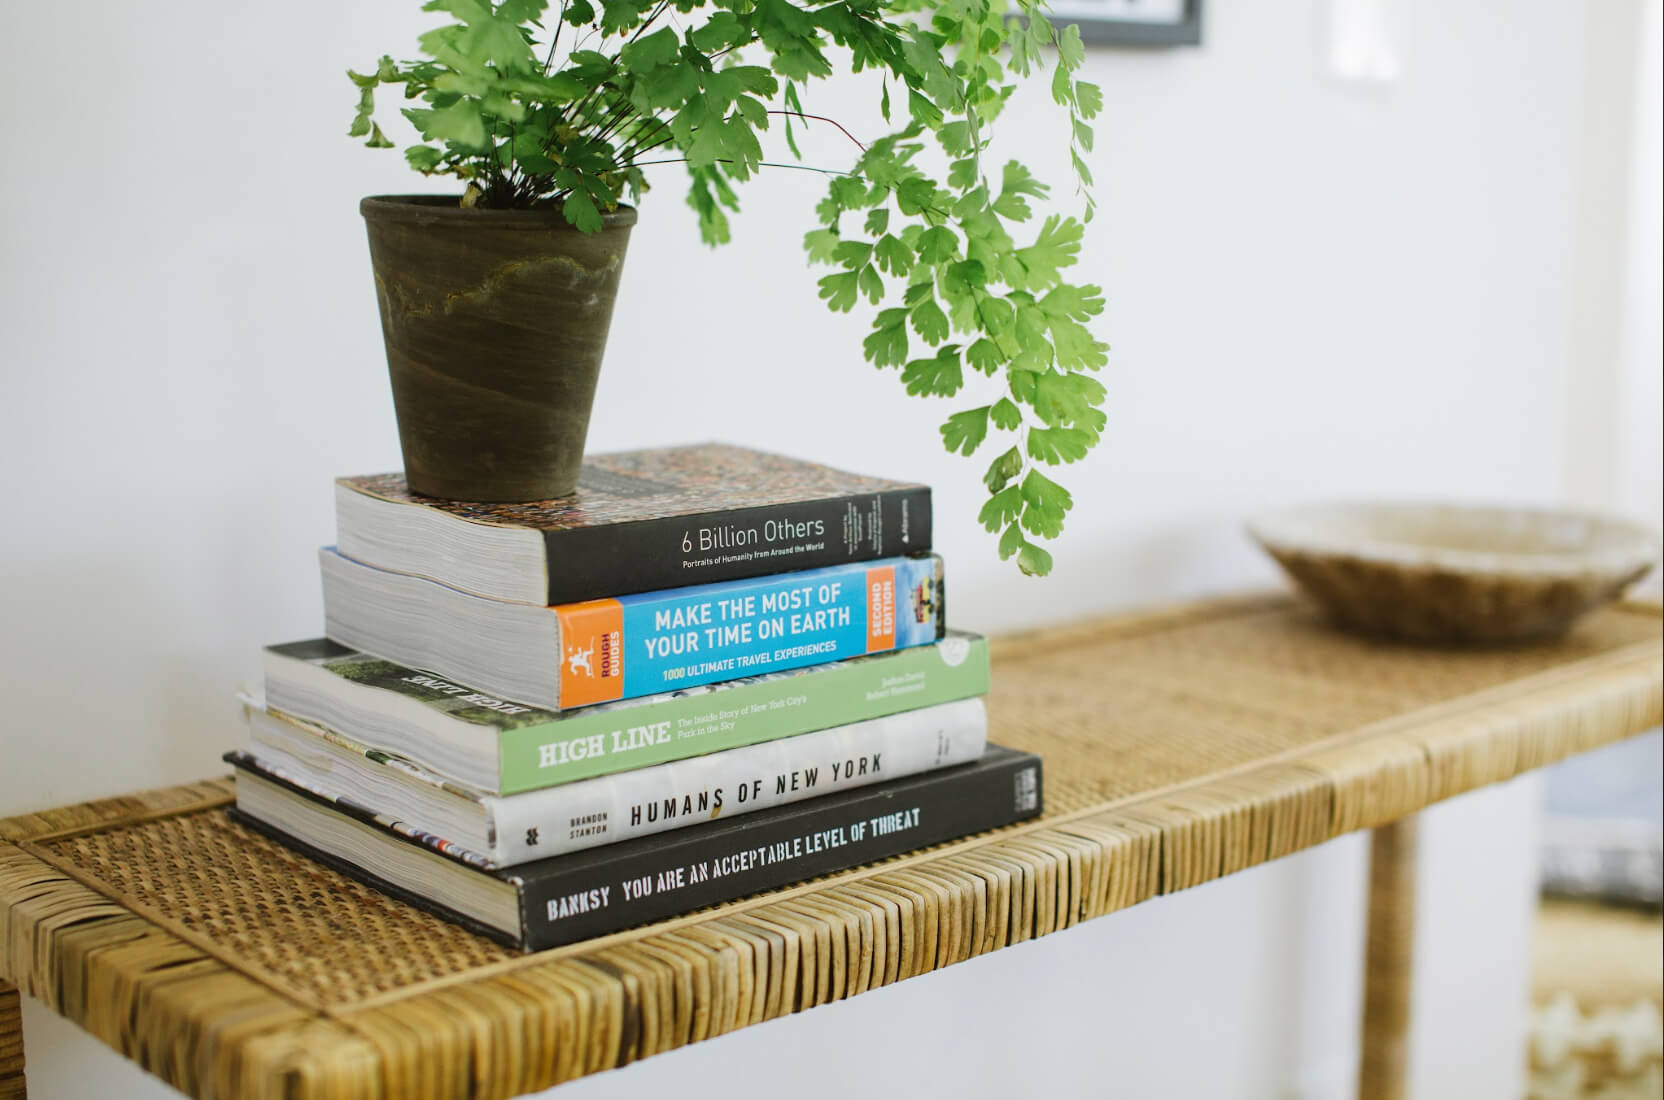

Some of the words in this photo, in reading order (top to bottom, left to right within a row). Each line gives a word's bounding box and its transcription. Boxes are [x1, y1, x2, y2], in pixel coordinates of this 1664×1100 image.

[682, 531, 692, 553] 6
[699, 524, 758, 551] Billion
[764, 518, 825, 542] Others
[683, 558, 713, 569] Portraits
[714, 556, 722, 565] of
[722, 551, 754, 563] Humanity
[754, 550, 770, 559] from
[771, 547, 794, 556] Around
[805, 542, 825, 551] World
[655, 603, 712, 631] MAKE
[718, 596, 756, 621] THE
[761, 587, 813, 614] MOST
[818, 583, 841, 605] OF
[872, 582, 882, 637] SECOND
[883, 581, 892, 635] EDITION
[601, 633, 610, 678] ROUGH
[610, 631, 620, 677] GUIDES
[645, 633, 699, 660] YOUR
[704, 623, 752, 649] TIME
[758, 617, 784, 640] ON
[791, 606, 850, 635] EARTH
[663, 667, 685, 681] 1000
[687, 657, 735, 676] ULTIMATE
[737, 650, 772, 668] TRAVEL
[774, 640, 837, 661] EXPERIENCES
[678, 718, 693, 728] The
[694, 712, 718, 724] Inside
[719, 709, 739, 720] Story
[740, 706, 749, 715] of
[750, 703, 767, 713] New
[768, 699, 785, 709] York
[678, 730, 695, 739] Park
[697, 727, 705, 735] in
[706, 725, 719, 733] the
[720, 721, 736, 730] Sky
[538, 734, 605, 768] HIGH
[611, 721, 671, 753] LINE
[630, 788, 723, 827] HUMANS
[737, 780, 762, 803] OF
[776, 767, 819, 795] NEW
[831, 752, 883, 783] YORK
[569, 824, 608, 839] STANTON
[570, 811, 608, 827] BRANDON
[547, 886, 610, 922] BANKSY
[622, 873, 654, 902] YOU
[656, 867, 685, 894] ARE
[689, 861, 709, 885] AN
[711, 838, 803, 880] ACCEPTABLE
[805, 828, 848, 854] LEVEL
[850, 822, 866, 843] OF
[869, 807, 921, 838] THREAT
